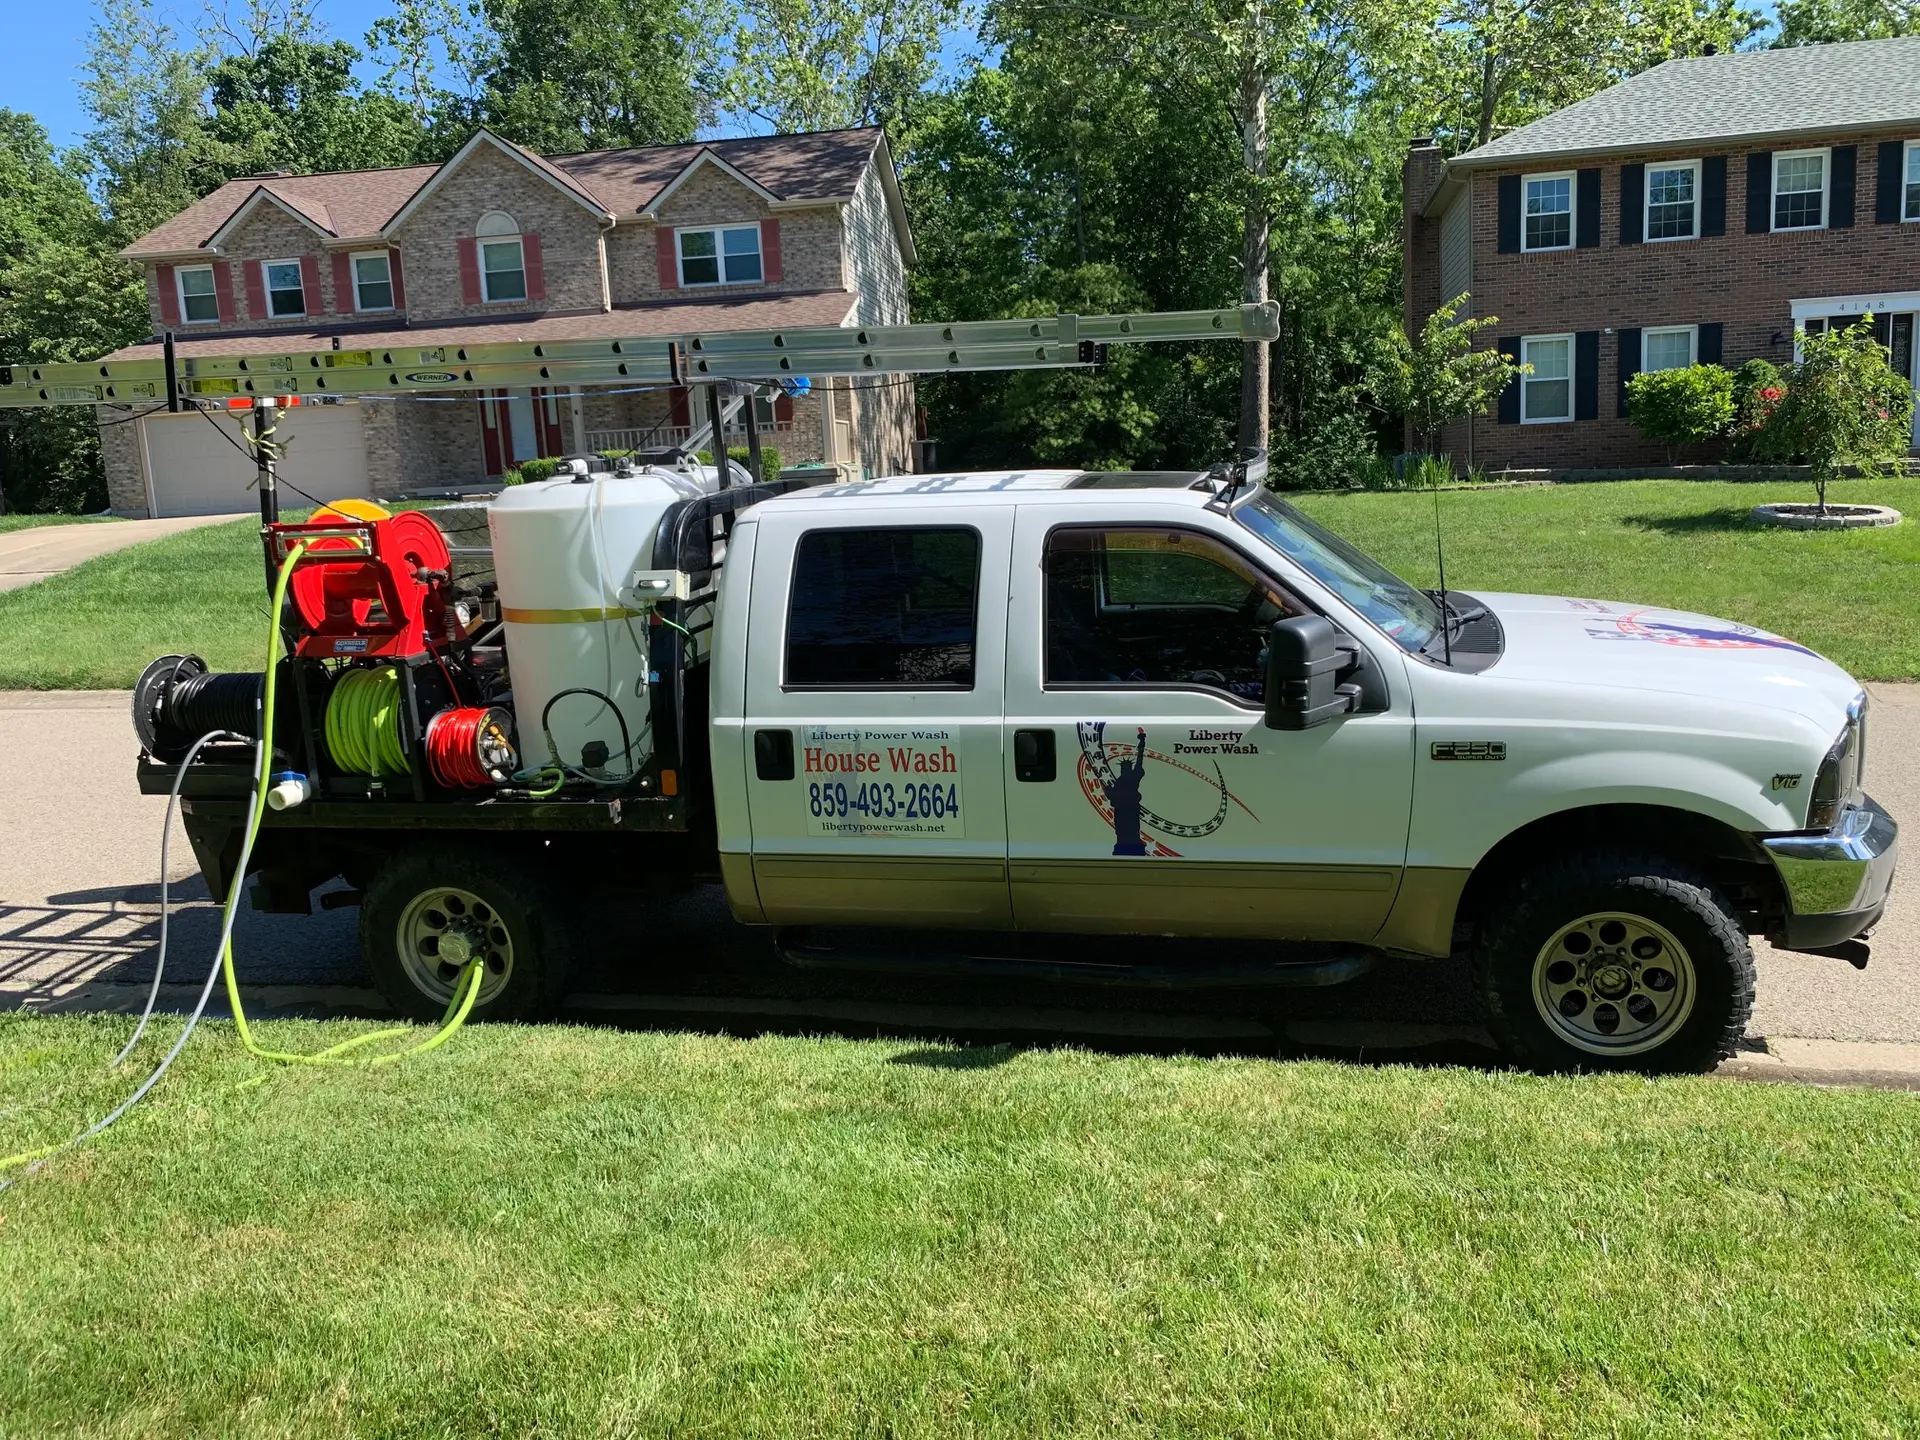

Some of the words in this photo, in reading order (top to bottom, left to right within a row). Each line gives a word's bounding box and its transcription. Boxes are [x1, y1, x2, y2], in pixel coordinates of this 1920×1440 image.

[1839, 301, 1885, 311] 4148
[812, 731, 861, 741] Liberty
[864, 731, 908, 740] Power
[911, 731, 949, 740] Wash
[1189, 729, 1243, 743] Liberty
[1174, 743, 1218, 754] Power
[1222, 743, 1259, 754] Wash
[804, 747, 881, 773] House
[887, 745, 958, 773] Wash
[1772, 776, 1801, 791] V10
[809, 782, 959, 818] 859-493-2664
[822, 822, 945, 834] libertypowerwash.net
